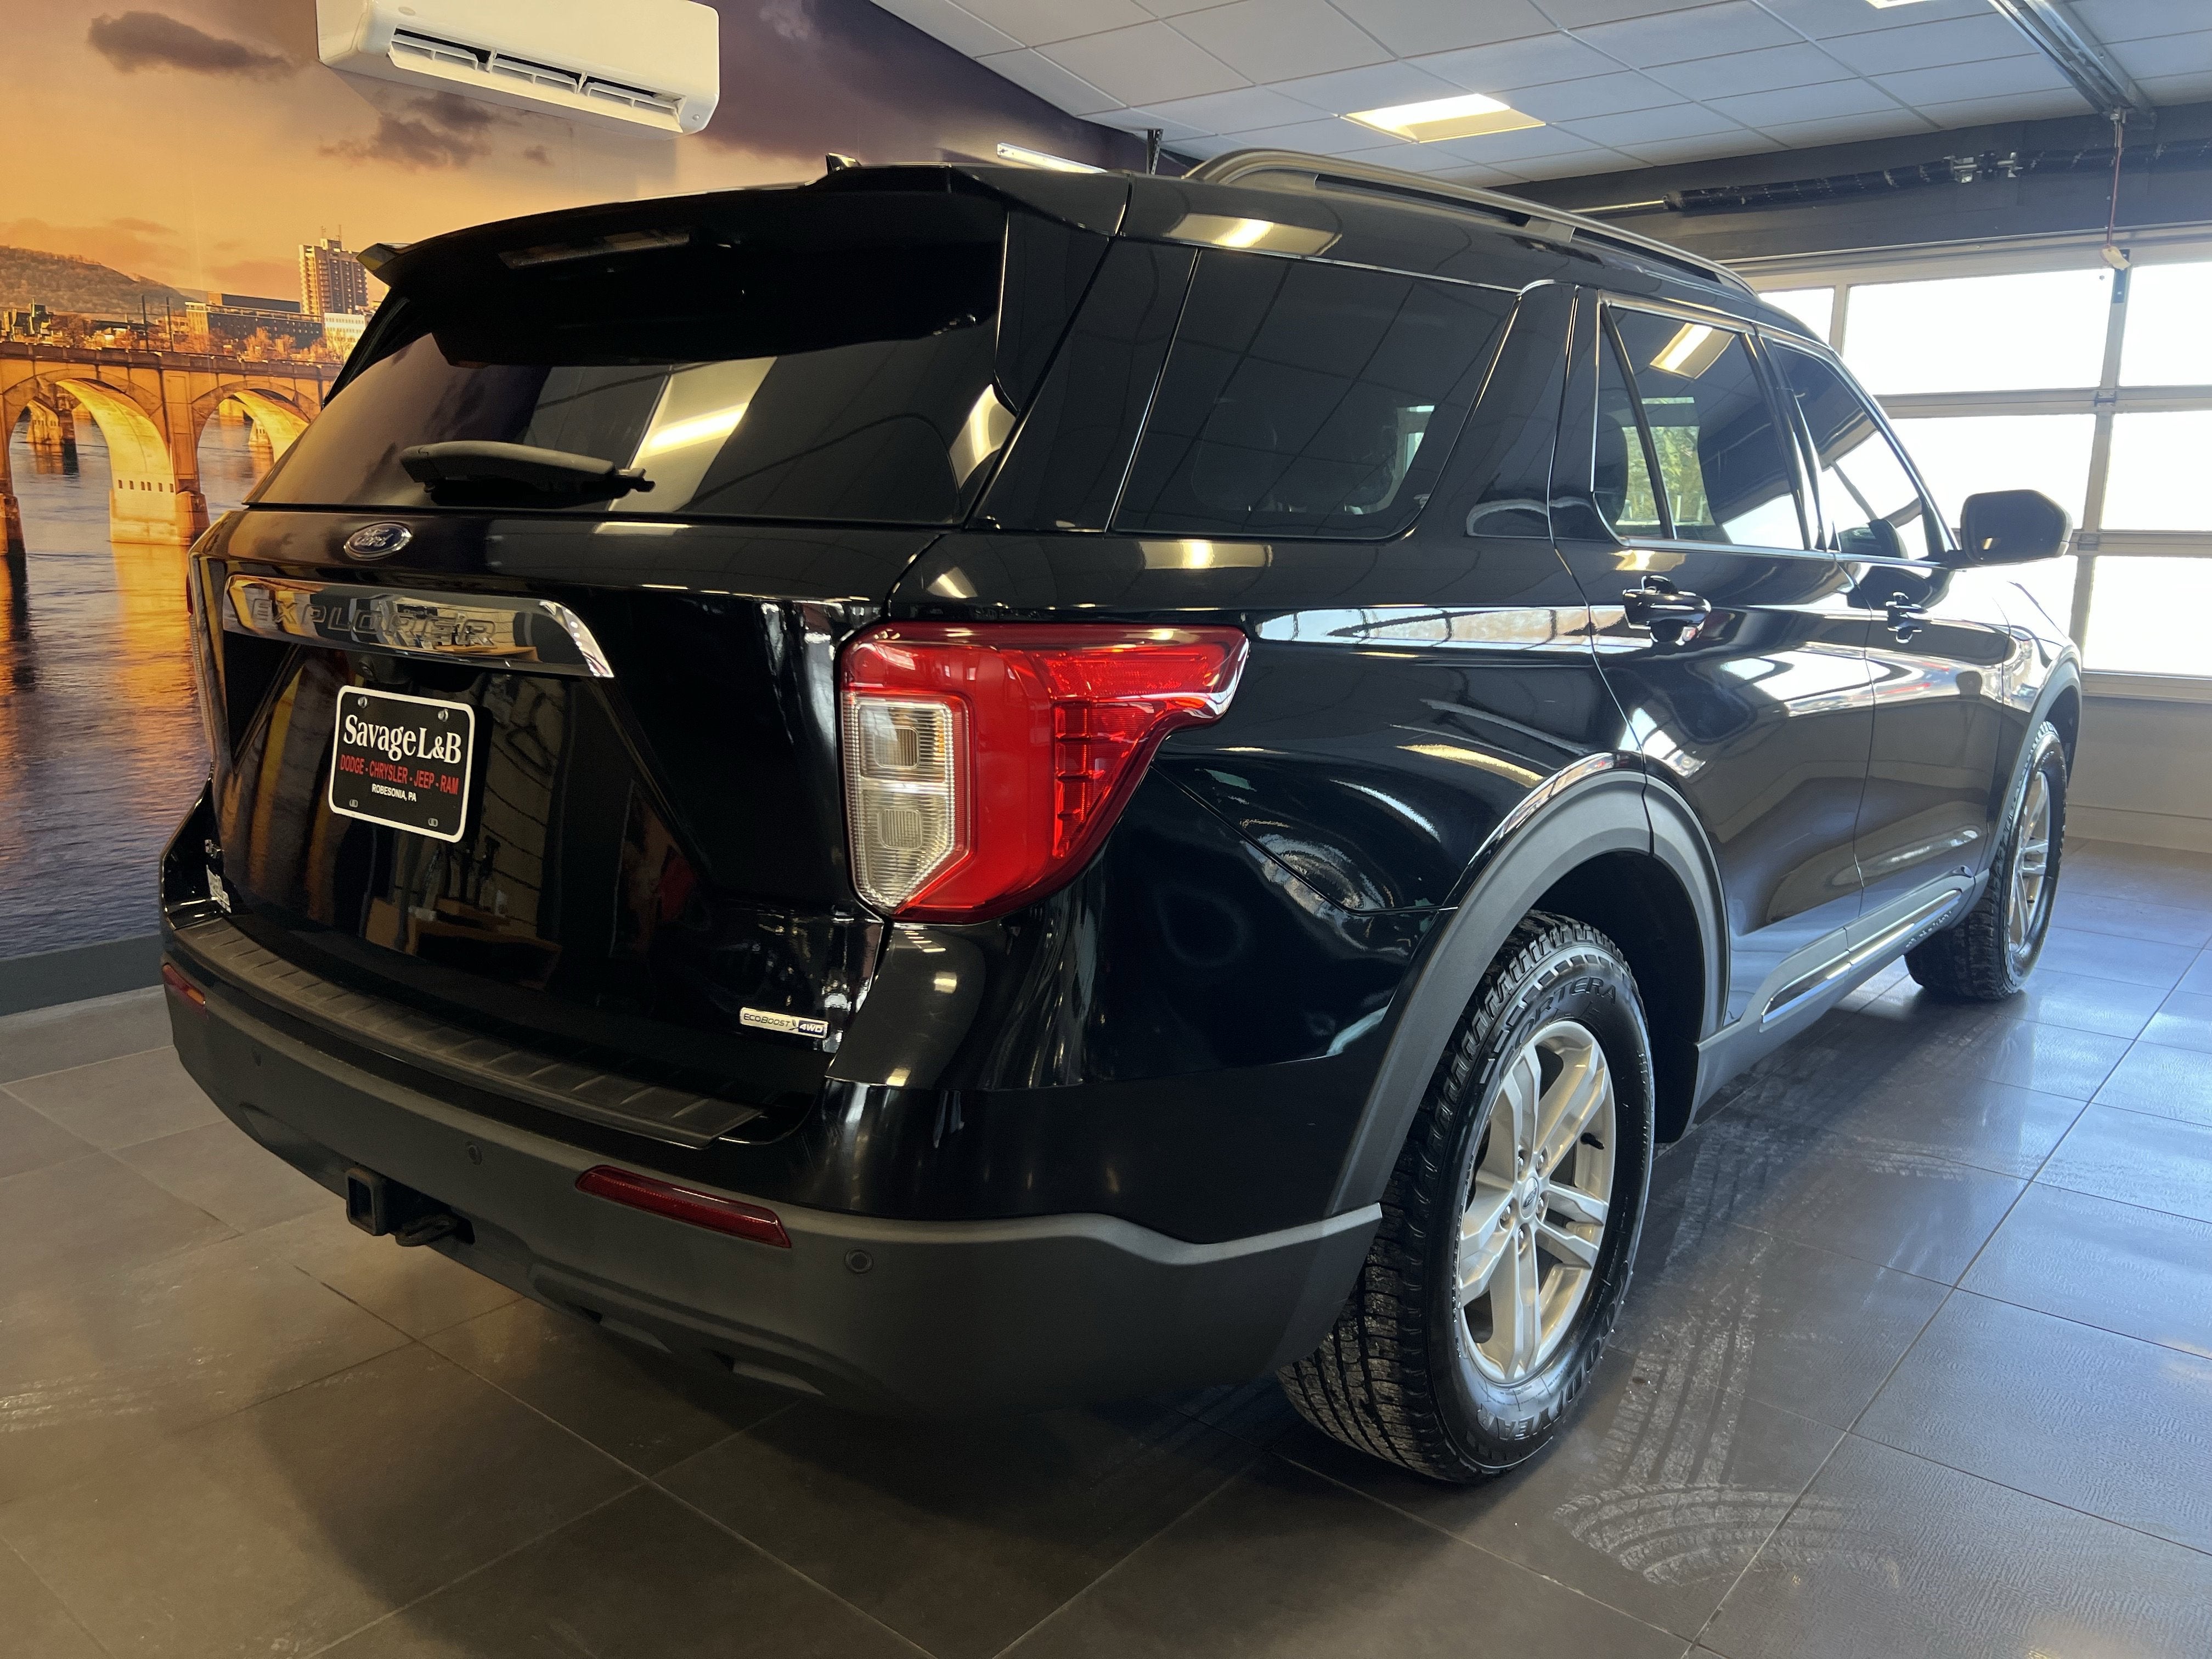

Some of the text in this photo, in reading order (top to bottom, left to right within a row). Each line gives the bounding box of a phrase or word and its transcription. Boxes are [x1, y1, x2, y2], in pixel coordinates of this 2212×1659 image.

[251, 598, 495, 646] EXPLORER
[340, 754, 459, 795] DODGE CHRYSLER JEEP RAM
[372, 783, 416, 802] ROBESONIA, PA
[799, 1023, 823, 1033] 4WD
